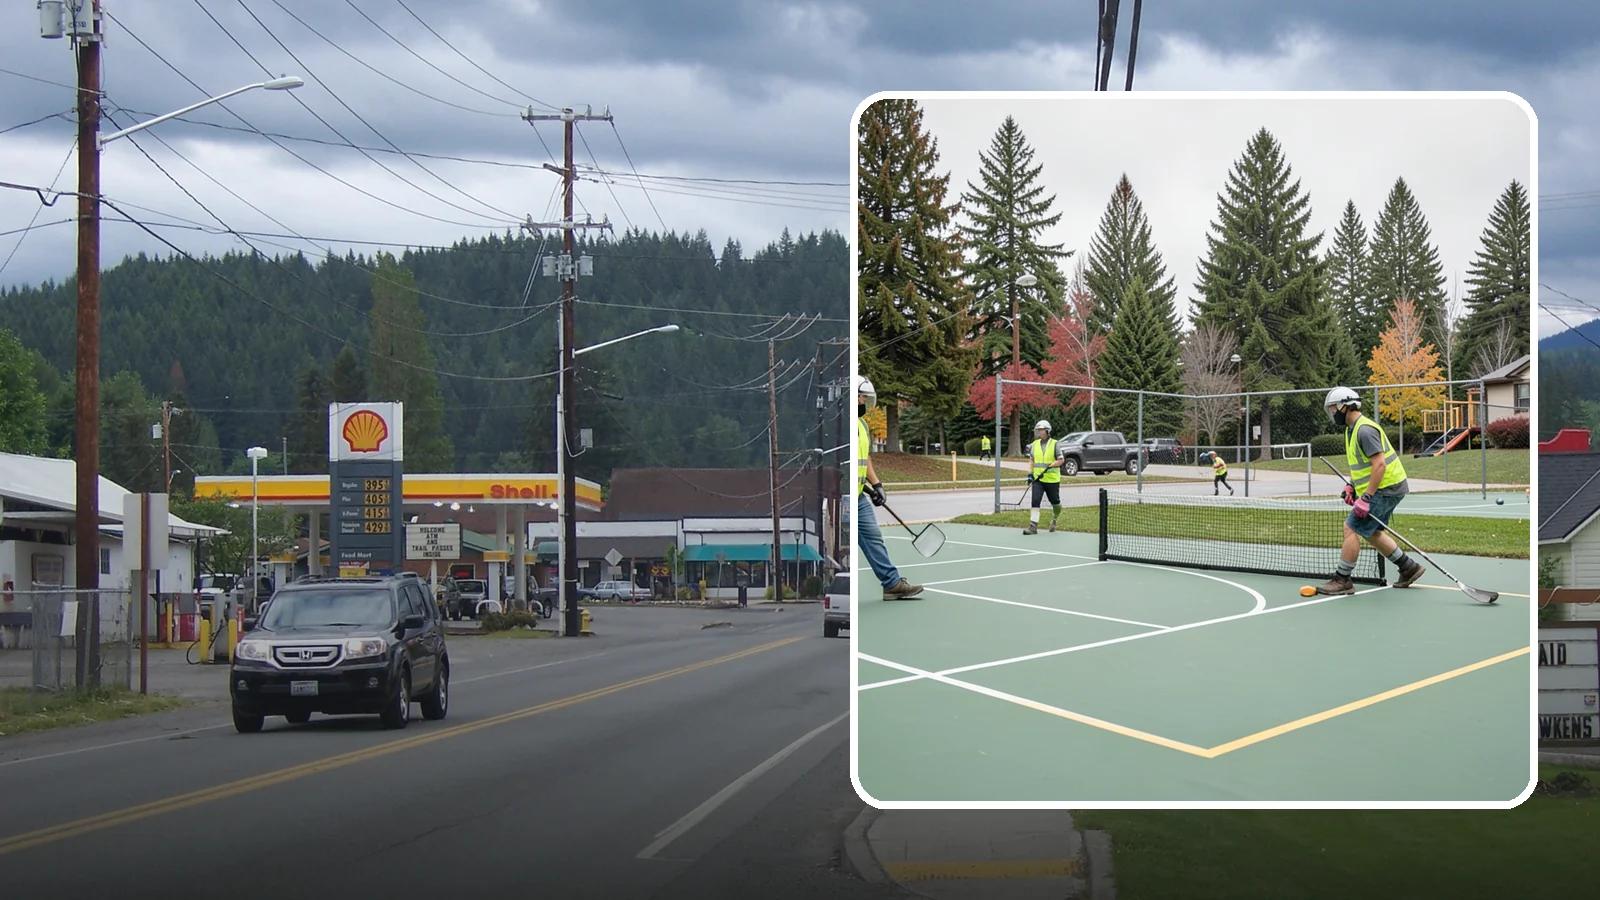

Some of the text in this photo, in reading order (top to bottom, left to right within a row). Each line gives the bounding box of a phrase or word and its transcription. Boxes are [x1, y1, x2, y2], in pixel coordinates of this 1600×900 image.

[365, 480, 384, 490] 395
[490, 484, 547, 499] Shell
[365, 494, 384, 504] 405
[365, 508, 384, 518] 415
[365, 522, 384, 533] 429
[1539, 642, 1567, 665] AID
